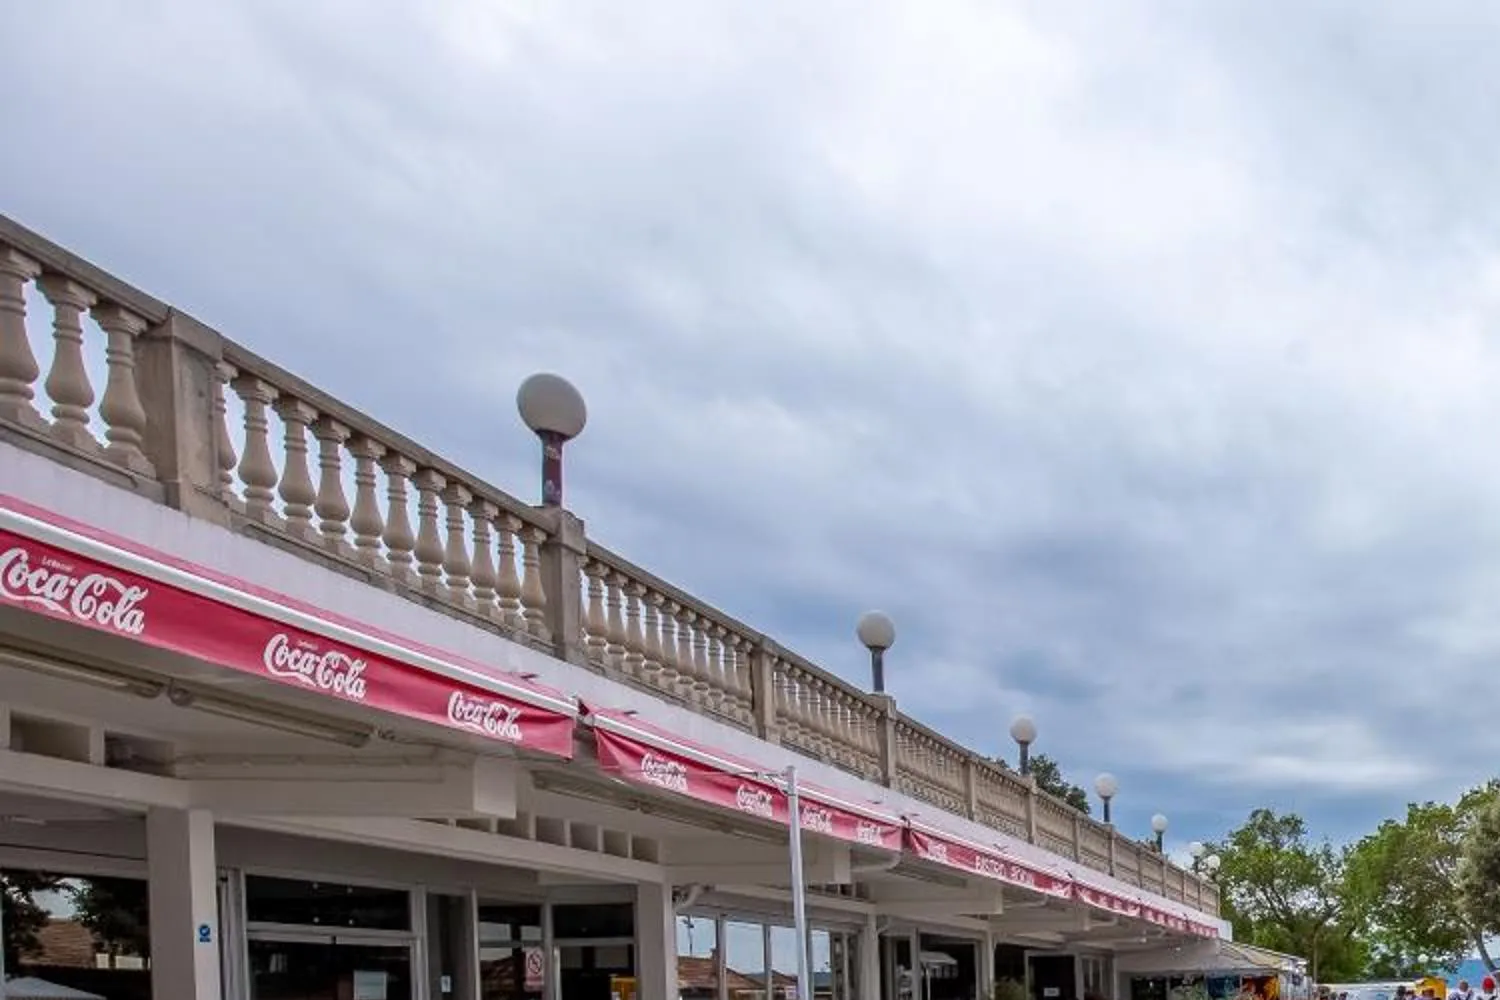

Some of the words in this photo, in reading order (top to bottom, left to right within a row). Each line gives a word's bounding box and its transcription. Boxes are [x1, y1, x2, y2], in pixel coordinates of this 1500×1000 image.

[0, 547, 149, 635] Coca-Cola
[263, 633, 367, 699] Coca-Cola
[448, 691, 522, 741] Coca-Cola
